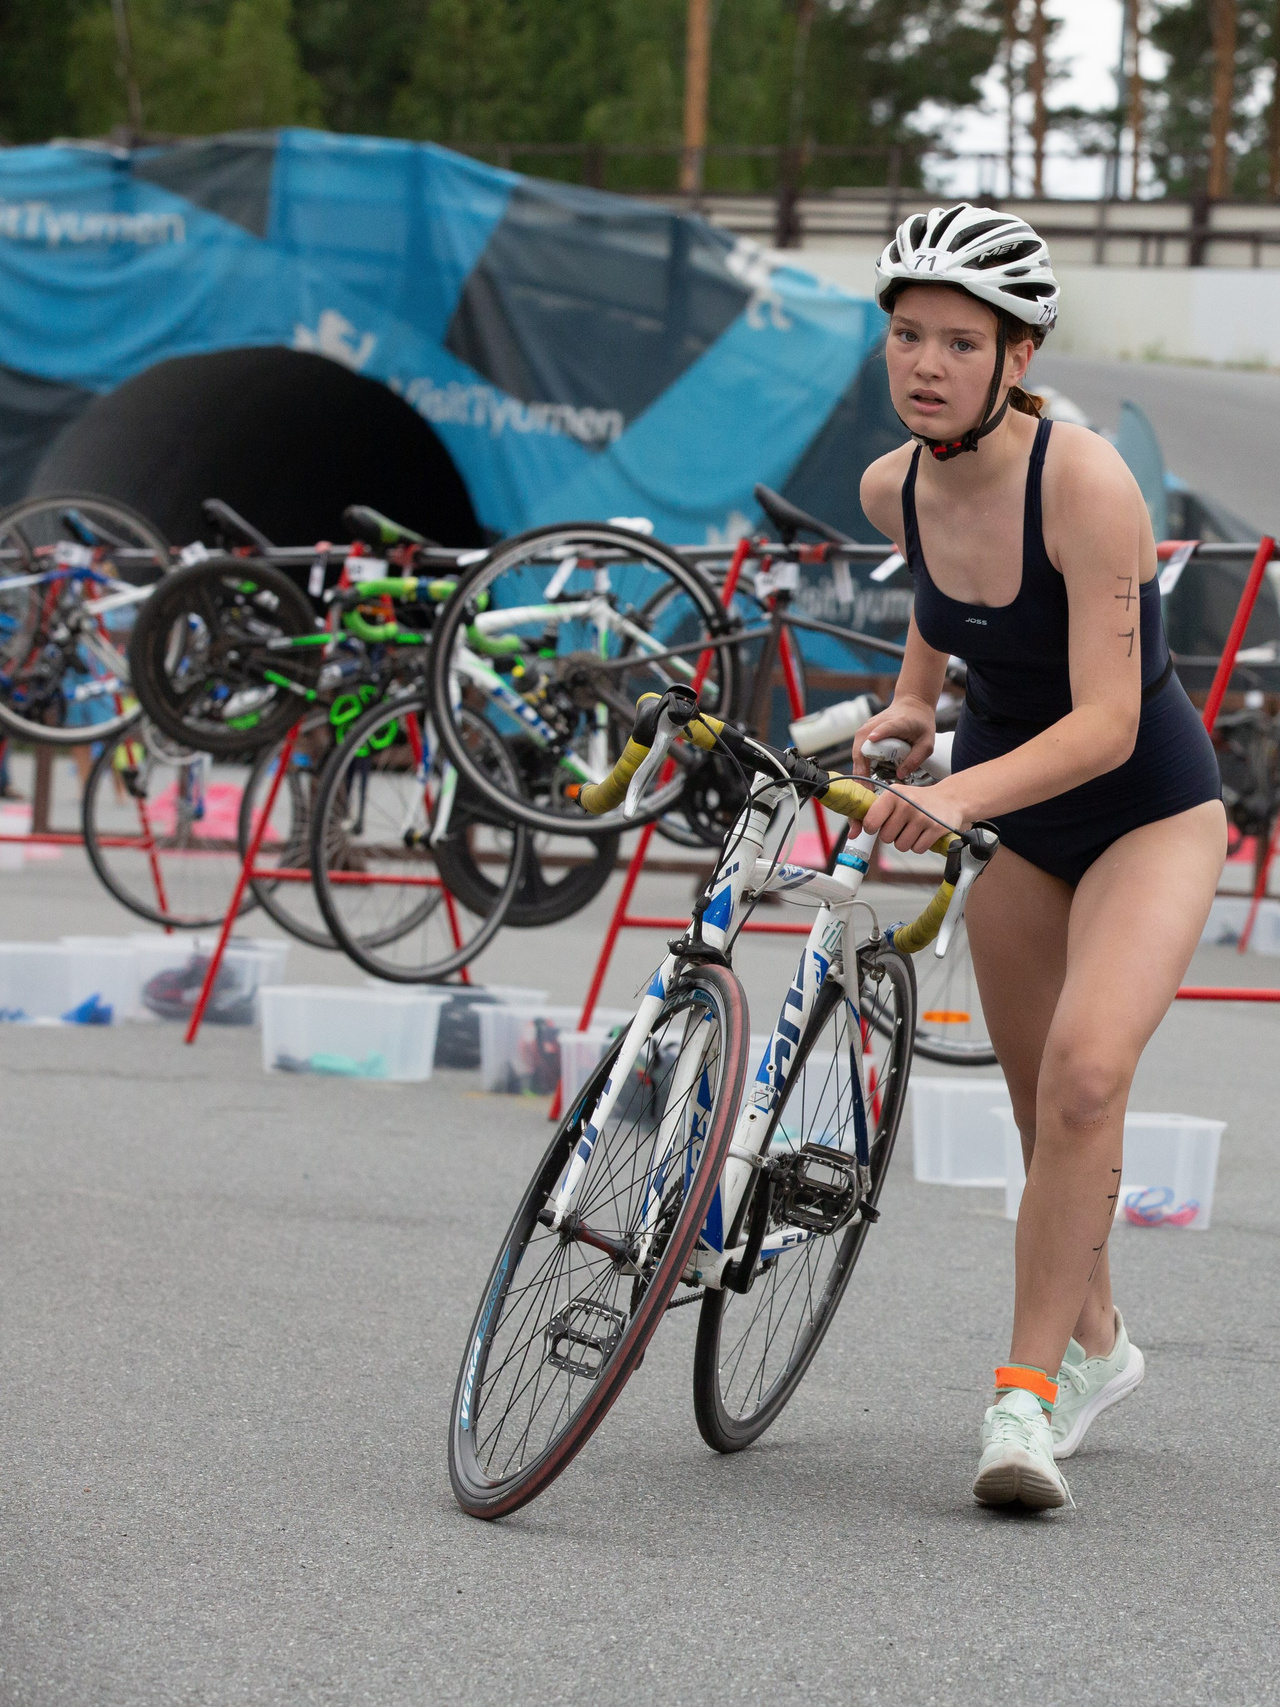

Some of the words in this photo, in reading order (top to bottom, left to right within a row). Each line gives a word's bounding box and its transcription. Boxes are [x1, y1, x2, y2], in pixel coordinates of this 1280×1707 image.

[978, 241, 1023, 263] MET
[914, 255, 937, 271] 71
[1039, 304, 1054, 323] 71
[965, 617, 988, 626] JOSS
